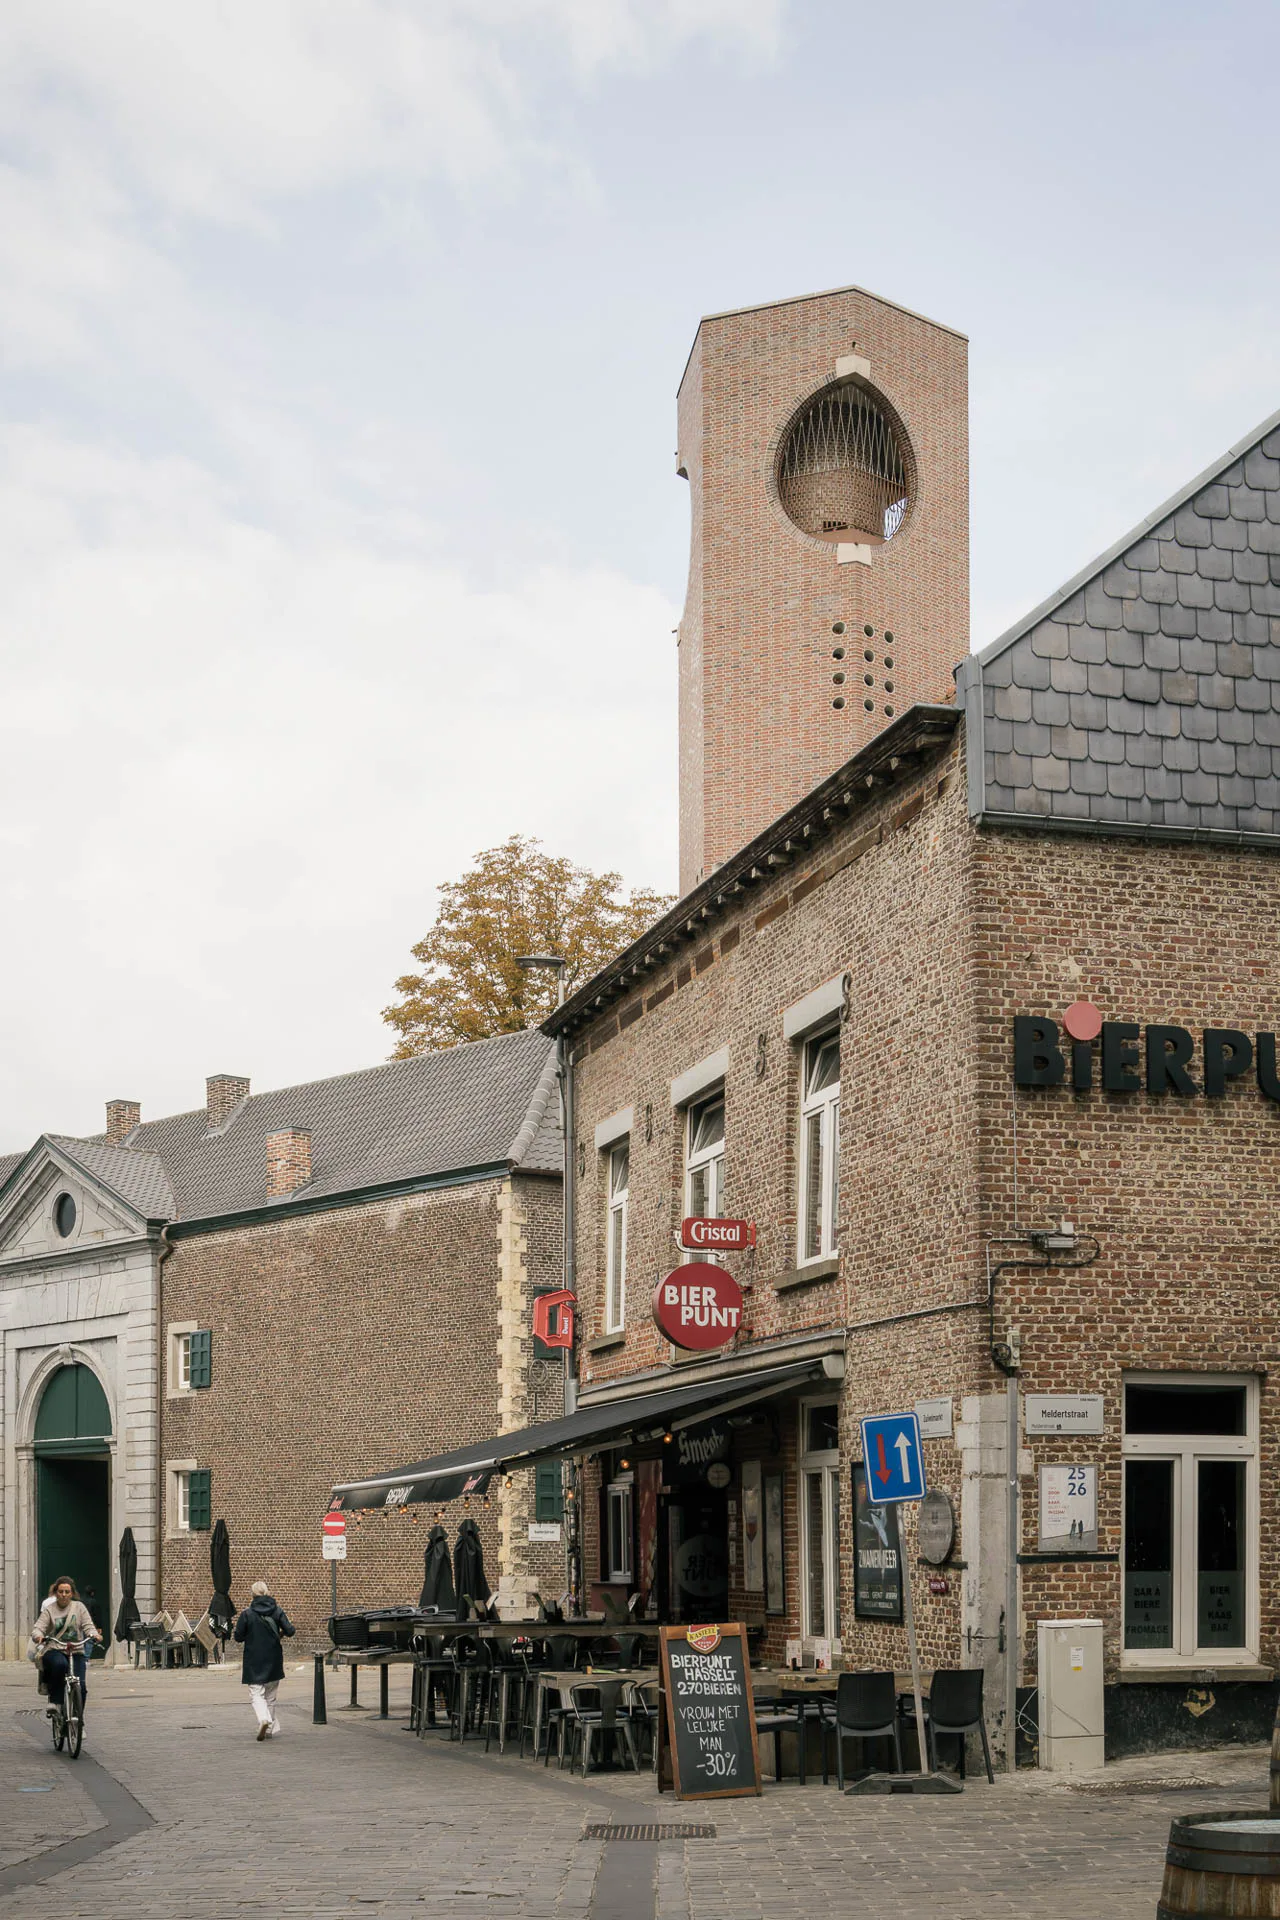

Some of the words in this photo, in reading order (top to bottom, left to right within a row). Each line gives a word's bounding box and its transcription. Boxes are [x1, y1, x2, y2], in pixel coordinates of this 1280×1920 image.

[690, 1221, 740, 1243] Cristal
[664, 1285, 717, 1306] BIER
[681, 1305, 740, 1327] PUNT
[1041, 1409, 1088, 1419] Meldertstraat
[1068, 1467, 1086, 1480] 25
[1068, 1483, 1087, 1496] 26
[1209, 1586, 1230, 1595] BIER
[1216, 1598, 1224, 1607] &
[1208, 1611, 1232, 1620] KAAS
[1126, 1625, 1168, 1634] FROMAGE
[1210, 1623, 1229, 1632] BAR
[671, 1654, 732, 1669] BIERPUNT
[684, 1667, 737, 1682] HASSELT
[679, 1706, 715, 1719] VROUW
[718, 1705, 740, 1719] MET
[686, 1720, 726, 1734] LELIJKE
[699, 1737, 723, 1751] MAN
[696, 1751, 737, 1776] -30%
